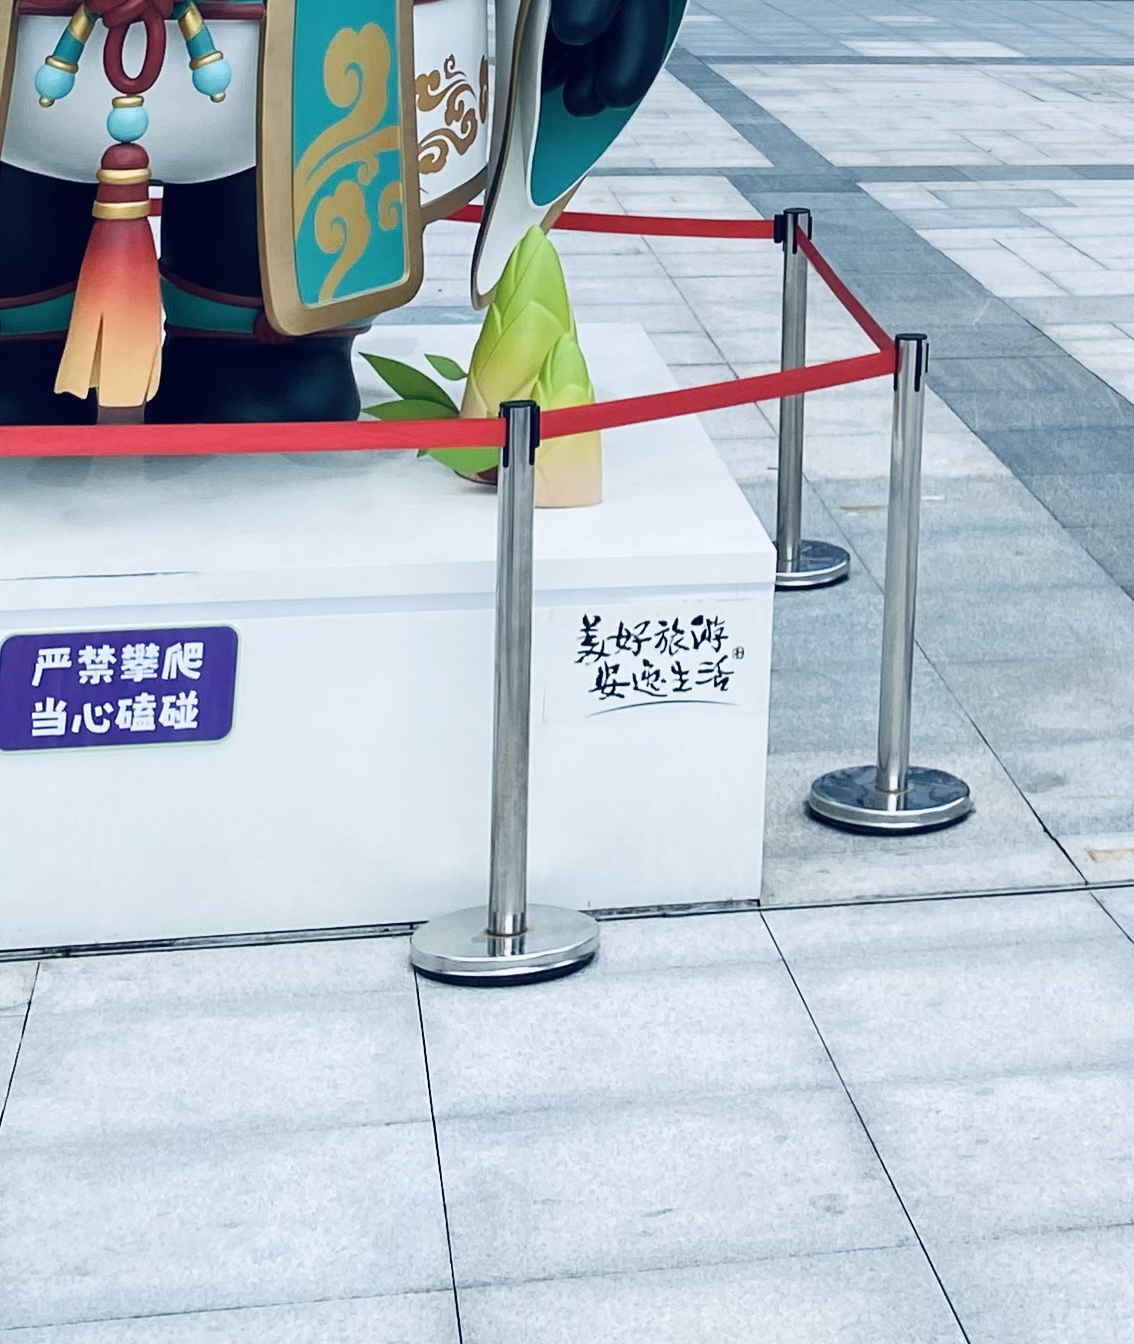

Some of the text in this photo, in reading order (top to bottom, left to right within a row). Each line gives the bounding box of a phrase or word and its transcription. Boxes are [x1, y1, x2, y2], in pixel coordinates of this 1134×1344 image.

[31, 642, 204, 687] 严禁攀爬
[31, 690, 199, 737] 当心磕碰
